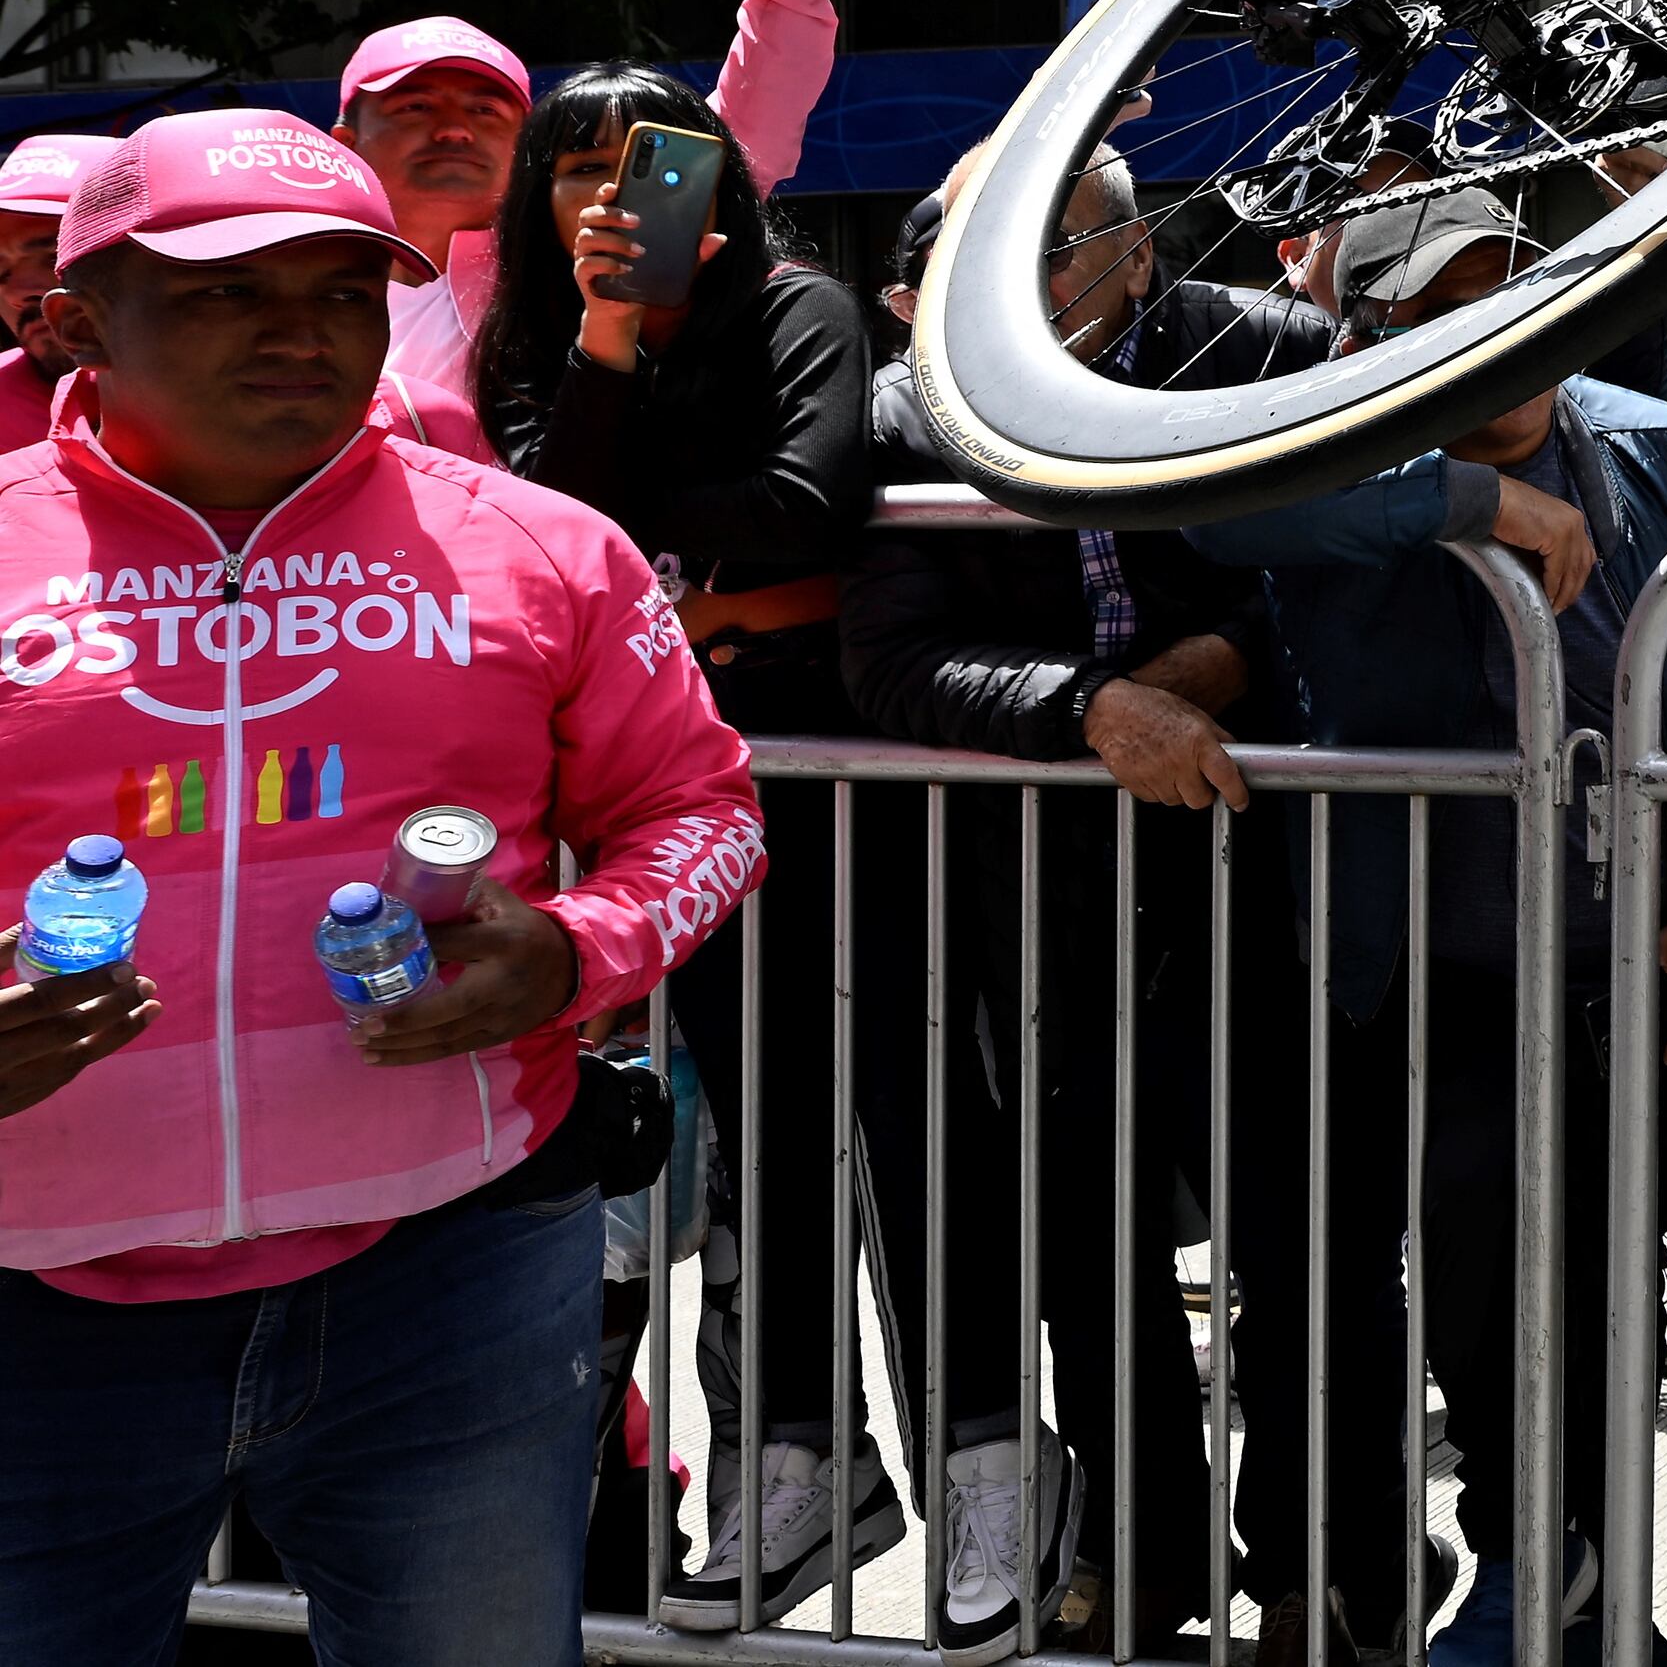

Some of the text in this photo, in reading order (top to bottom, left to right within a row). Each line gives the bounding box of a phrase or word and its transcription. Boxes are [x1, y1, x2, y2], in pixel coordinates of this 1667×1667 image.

[232, 128, 331, 152] MANZANA
[919, 364, 945, 409] 5000
[936, 406, 971, 442] PRIX
[965, 438, 1027, 472] GRAND
[46, 551, 366, 606] MANZANA
